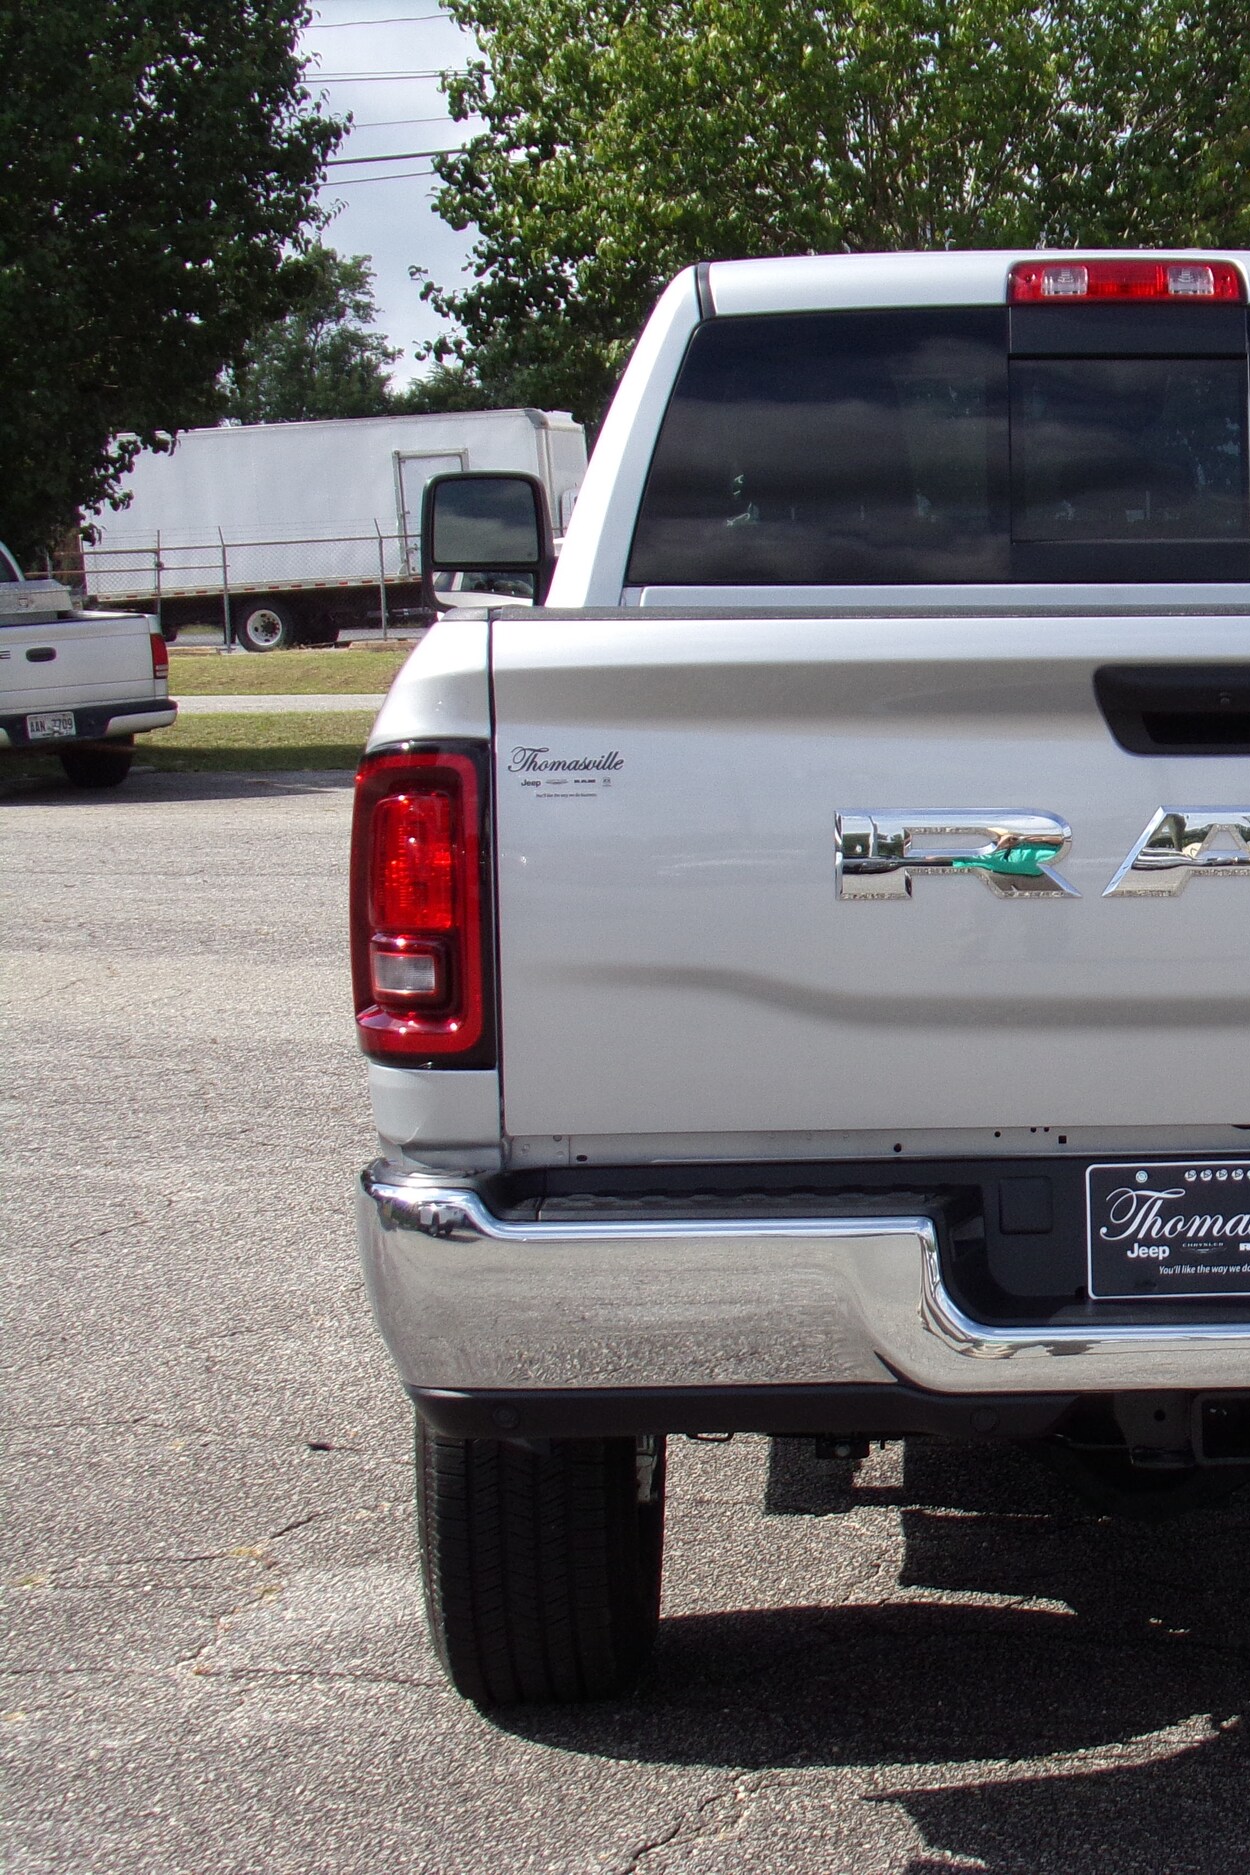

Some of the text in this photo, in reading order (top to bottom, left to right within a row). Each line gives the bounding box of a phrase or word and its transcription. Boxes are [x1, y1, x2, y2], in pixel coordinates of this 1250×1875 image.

[508, 746, 625, 772] Thomasville
[521, 779, 541, 787] Jeep
[1127, 1243, 1170, 1260] Jeep
[1159, 1265, 1181, 1275] You'll
[1181, 1265, 1196, 1274] like
[1197, 1264, 1210, 1274] the
[1211, 1265, 1228, 1275] way
[1229, 1264, 1241, 1272] we
